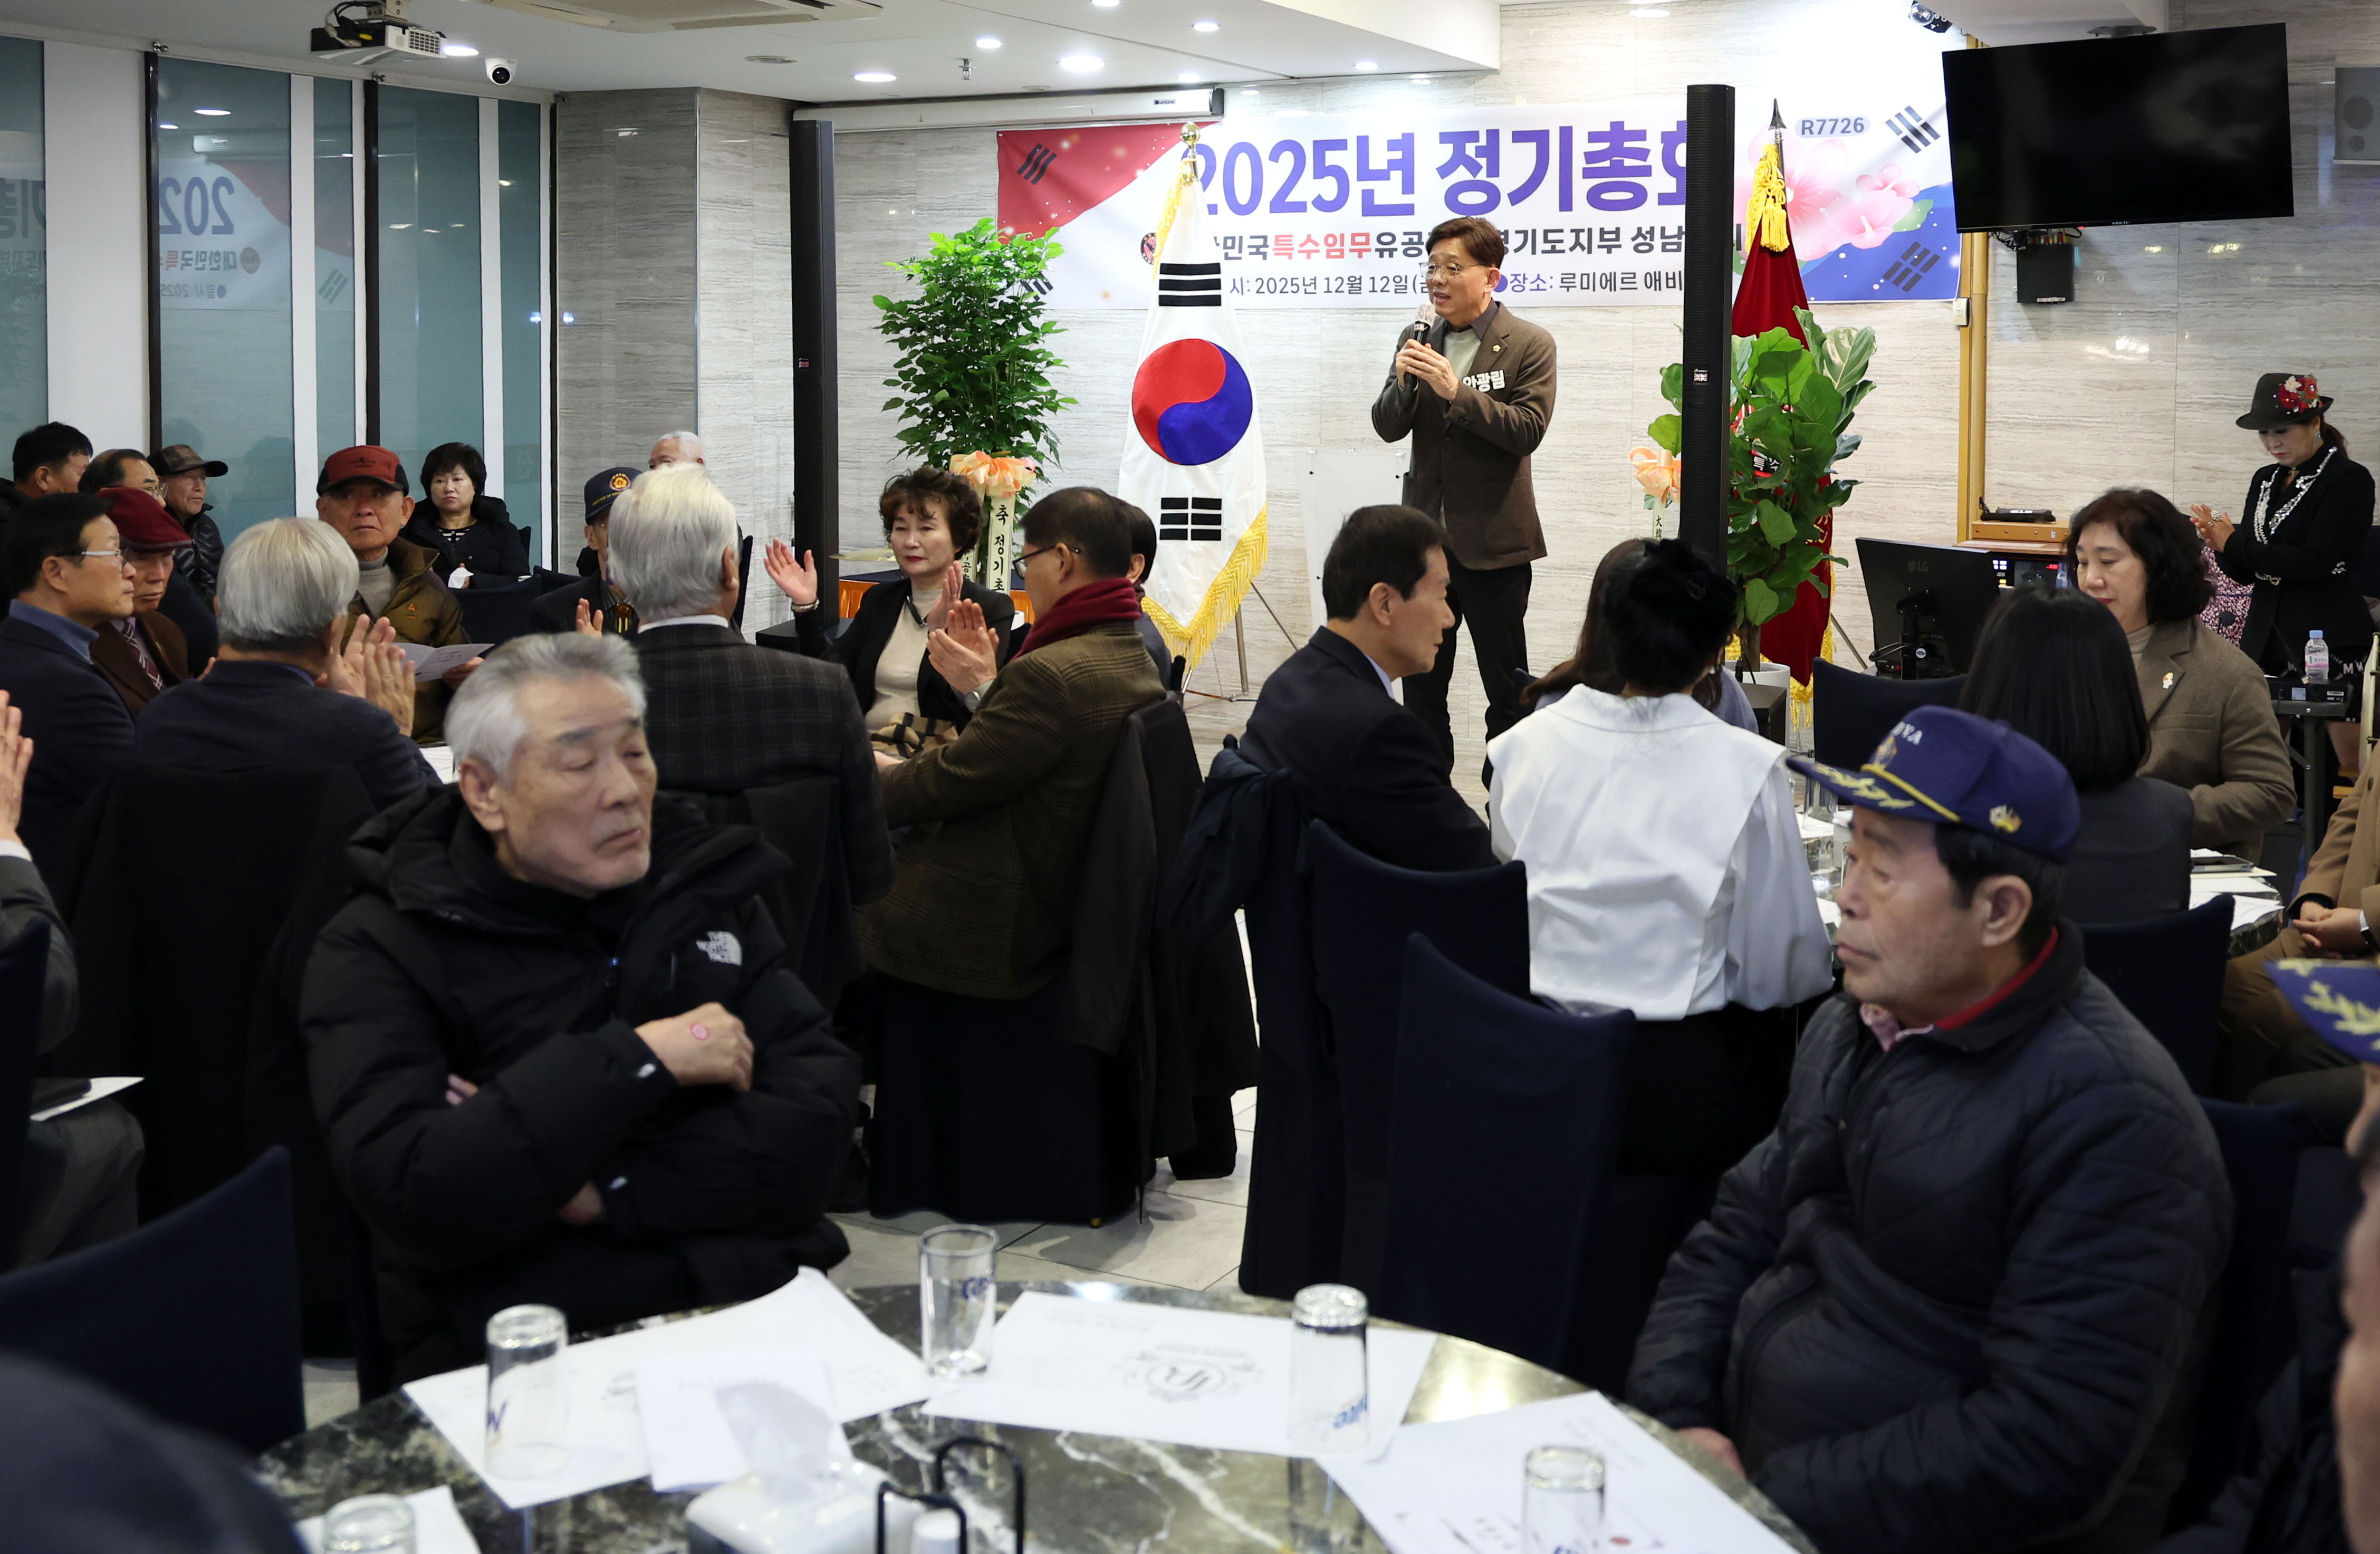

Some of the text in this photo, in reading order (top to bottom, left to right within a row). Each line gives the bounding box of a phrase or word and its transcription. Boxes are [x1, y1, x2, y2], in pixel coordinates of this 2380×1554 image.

[1801, 118, 1865, 136] R7726
[1181, 133, 1415, 217] 2025년
[1631, 226, 1685, 254] 성남
[1255, 276, 1317, 295] 2025년
[1323, 275, 1362, 295] 12월
[1510, 273, 1553, 293] 장소:
[1559, 271, 1638, 292] 루미에르
[1463, 370, 1505, 392] 안광림
[995, 504, 1009, 526] 축
